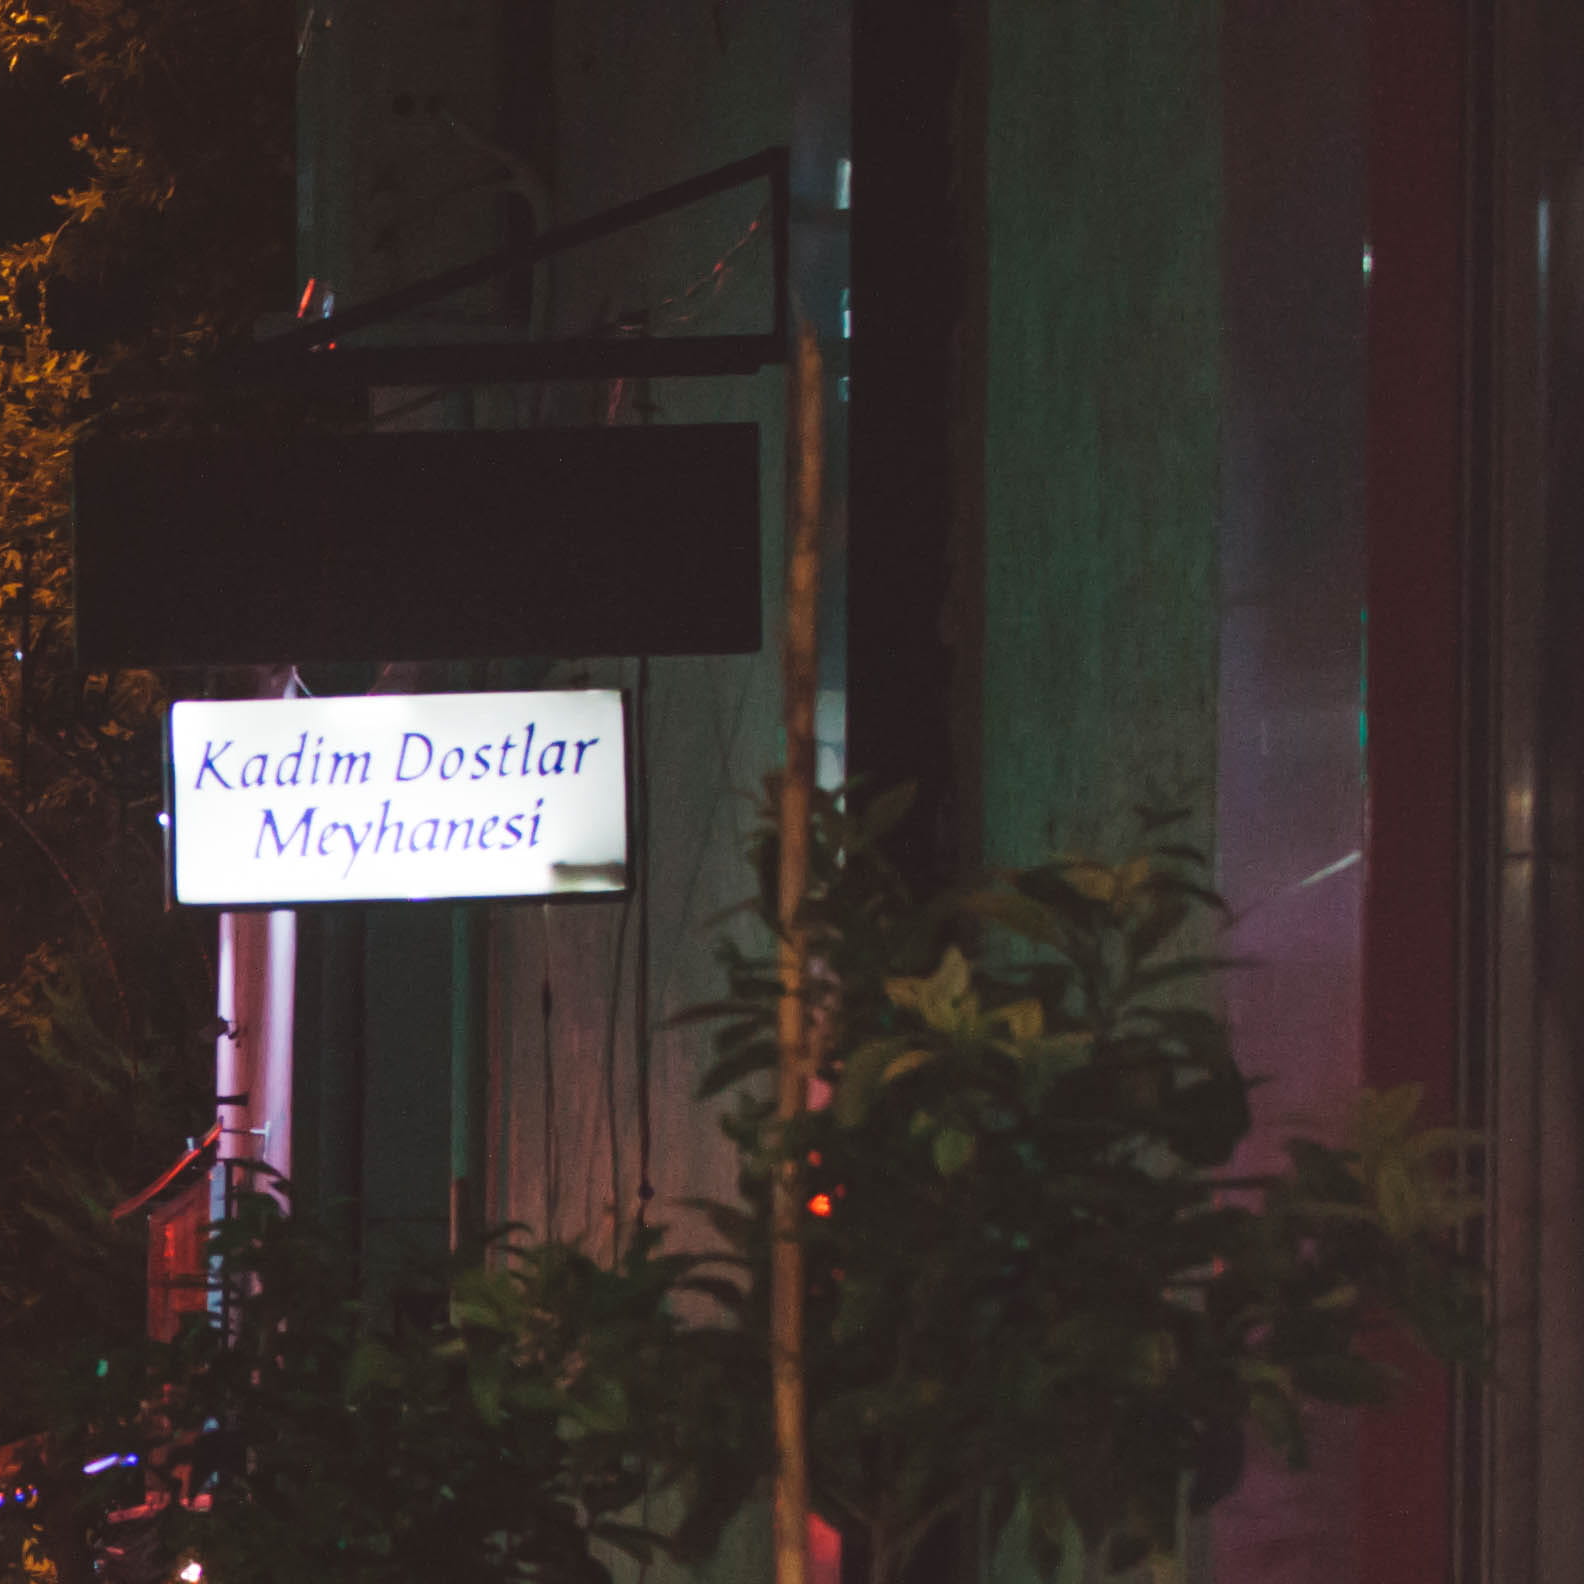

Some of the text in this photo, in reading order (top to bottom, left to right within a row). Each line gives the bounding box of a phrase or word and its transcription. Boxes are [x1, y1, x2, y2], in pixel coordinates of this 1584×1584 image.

[193, 721, 601, 791] Kadim Dostlar
[253, 797, 545, 880] Meyhanesi
